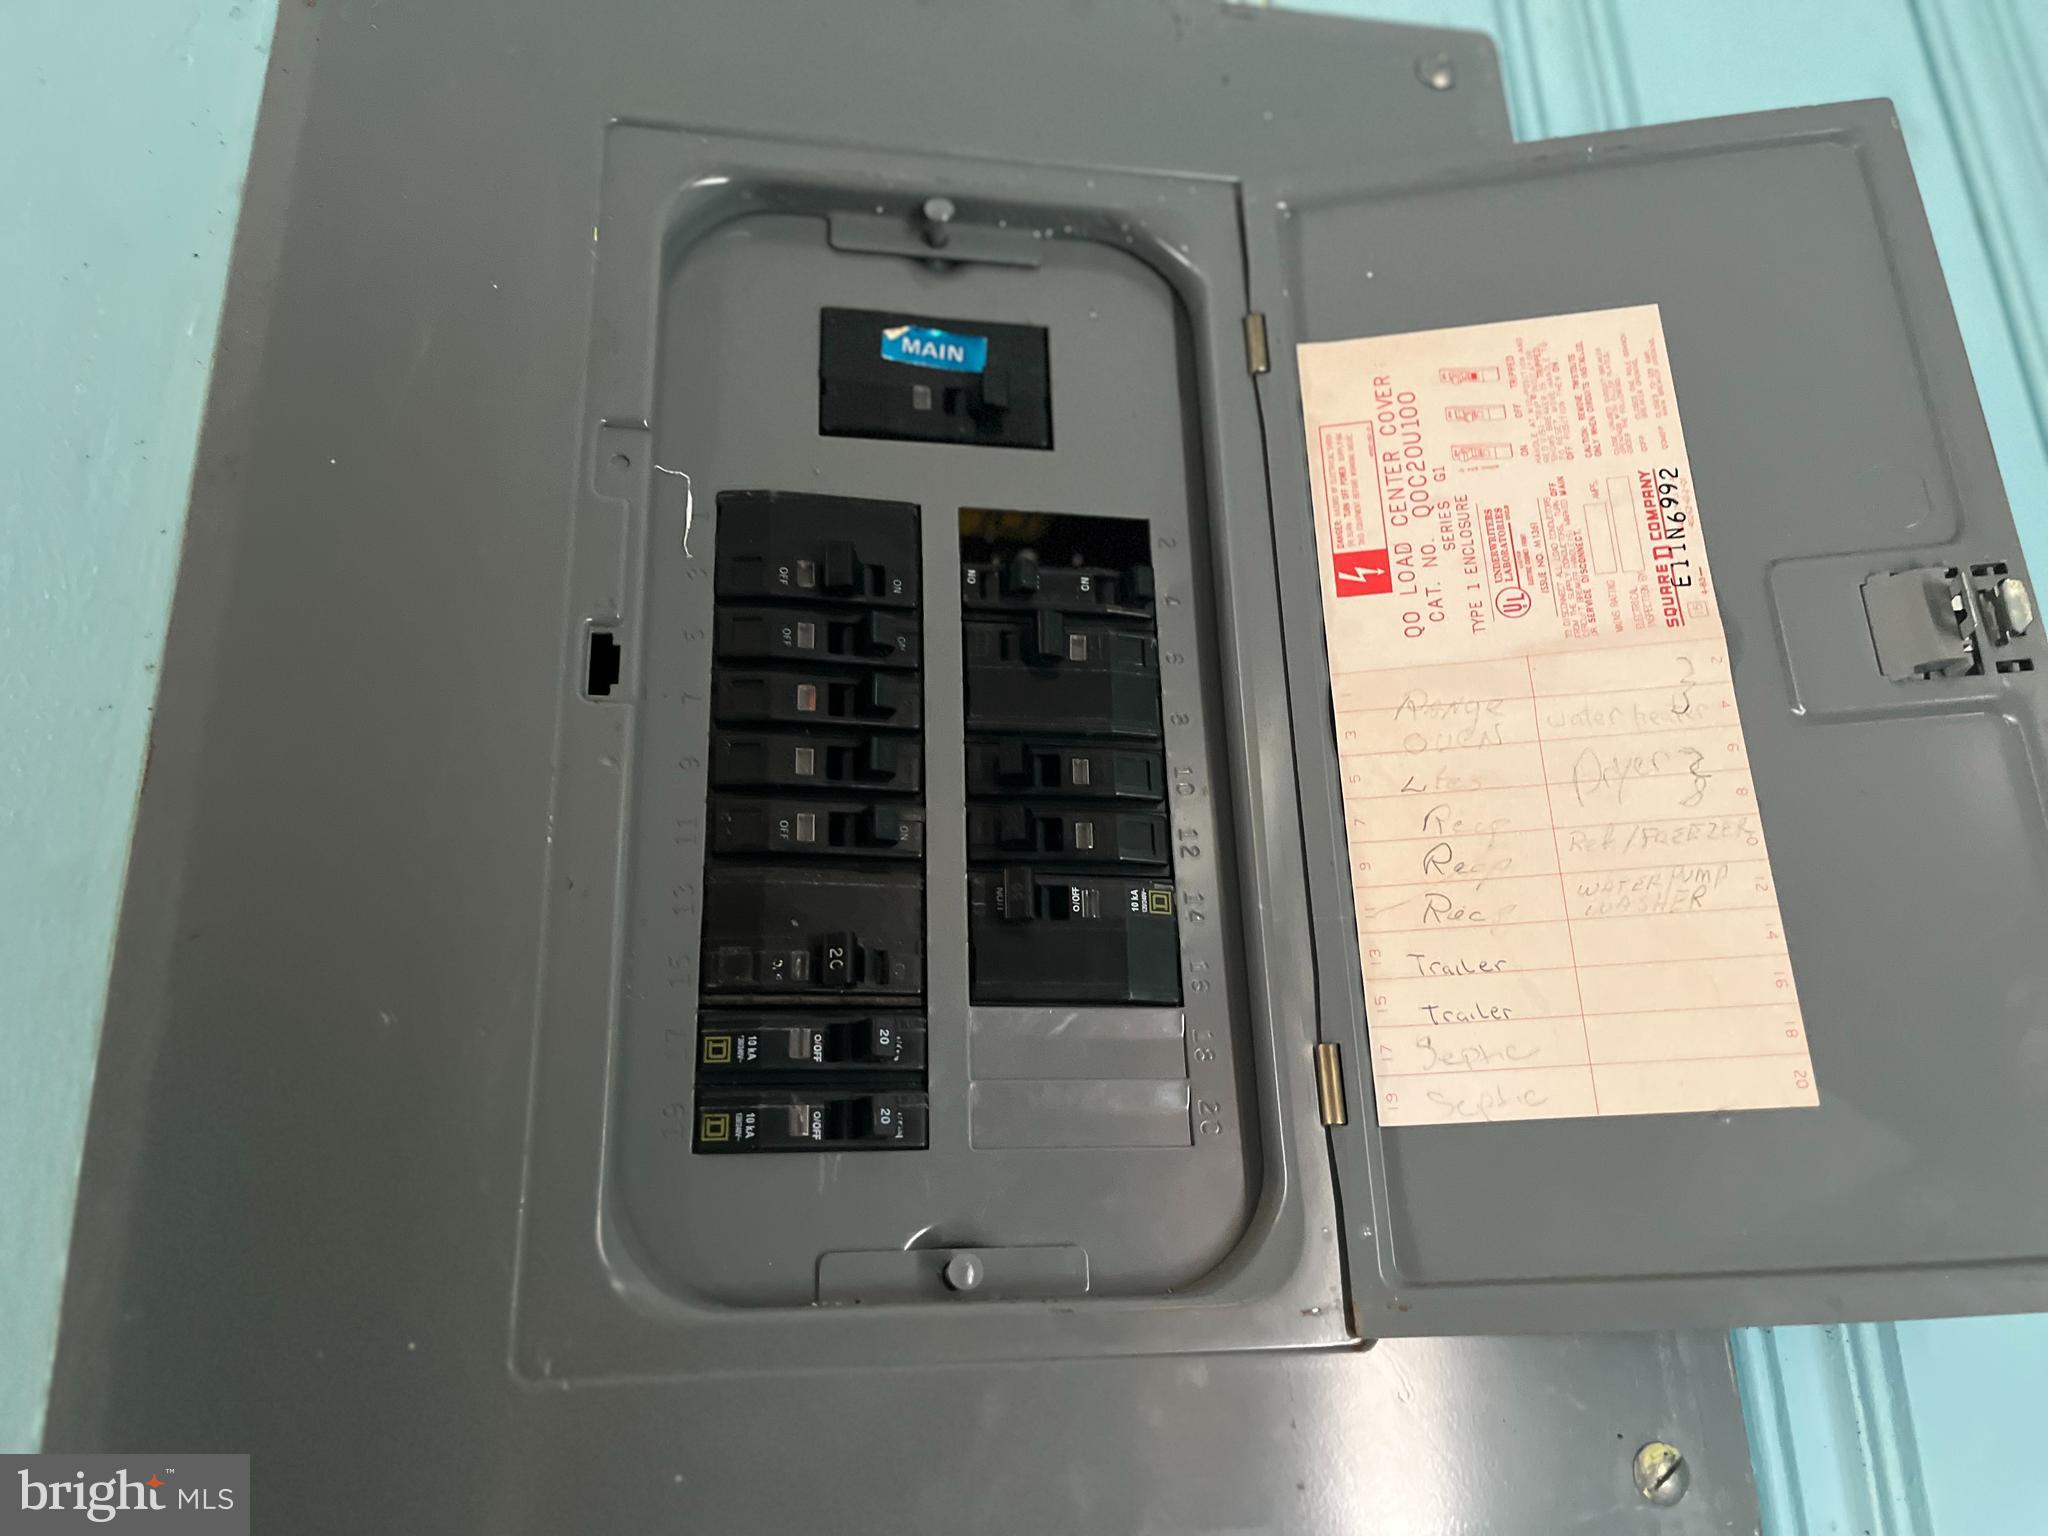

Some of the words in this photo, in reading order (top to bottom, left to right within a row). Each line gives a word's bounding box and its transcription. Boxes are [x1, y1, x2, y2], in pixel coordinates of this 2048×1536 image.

[901, 336, 964, 362] MAIN
[1372, 374, 1397, 435] COVER
[1512, 402, 1522, 418] OFF
[1395, 389, 1435, 518] QOC20U100
[1519, 444, 1529, 456] ON
[1431, 464, 1446, 482] G1
[1381, 450, 1409, 527] CENTER
[1637, 469, 1662, 541] COMPANY
[1436, 499, 1456, 551] SERIES
[1453, 493, 1478, 574] ENCLOSURE
[1158, 536, 1177, 549] 2
[1483, 507, 1503, 583] UNDERWRITERS
[1493, 506, 1513, 582] LABORATORIES
[1652, 544, 1673, 560] D
[1418, 537, 1438, 568] NO.
[779, 565, 789, 585] OFF
[967, 568, 976, 584] ON
[1393, 541, 1418, 595] LOAD
[893, 579, 902, 594] ON
[1080, 576, 1090, 591] ON
[1424, 581, 1446, 622] CAT.
[1655, 563, 1680, 628] SQUARE
[1582, 588, 1596, 623] SERVICE
[1401, 609, 1426, 638] QO
[1468, 599, 1486, 634] TYPE
[782, 627, 792, 646] OFF
[1710, 655, 1724, 665] 2
[1720, 700, 1731, 709] 4
[1345, 730, 1357, 740] 3
[1727, 743, 1740, 752] 6
[1174, 765, 1196, 797] 10
[1348, 774, 1361, 784] 5
[1736, 787, 1748, 796] 8
[779, 819, 789, 840] OFF
[1354, 818, 1366, 826] 7
[1177, 827, 1200, 858] 12
[1359, 862, 1372, 871] 9
[1754, 876, 1768, 893] 12
[1071, 887, 1080, 912] O/OFF
[1130, 889, 1139, 900] kA
[1130, 901, 1139, 912] 10
[1183, 891, 1206, 923] 14
[1764, 923, 1779, 941] 14
[1369, 948, 1382, 967] 13
[1405, 952, 1508, 976] Trailer
[1189, 960, 1210, 993] 16
[1773, 971, 1789, 990] 16
[1374, 995, 1387, 1013] 15
[1419, 1002, 1513, 1026] Trailer
[879, 1029, 890, 1045] 20
[1785, 1021, 1799, 1039] 18
[748, 1036, 757, 1046] 10
[813, 1034, 822, 1062] O/OFF
[747, 1049, 757, 1061] kA
[1379, 1044, 1393, 1063] 17
[1792, 1069, 1808, 1090] 20
[1385, 1093, 1398, 1111] 19
[746, 1113, 755, 1123] 10
[812, 1111, 821, 1140] O/OFF
[880, 1108, 891, 1125] 20
[745, 1125, 755, 1139] kA
